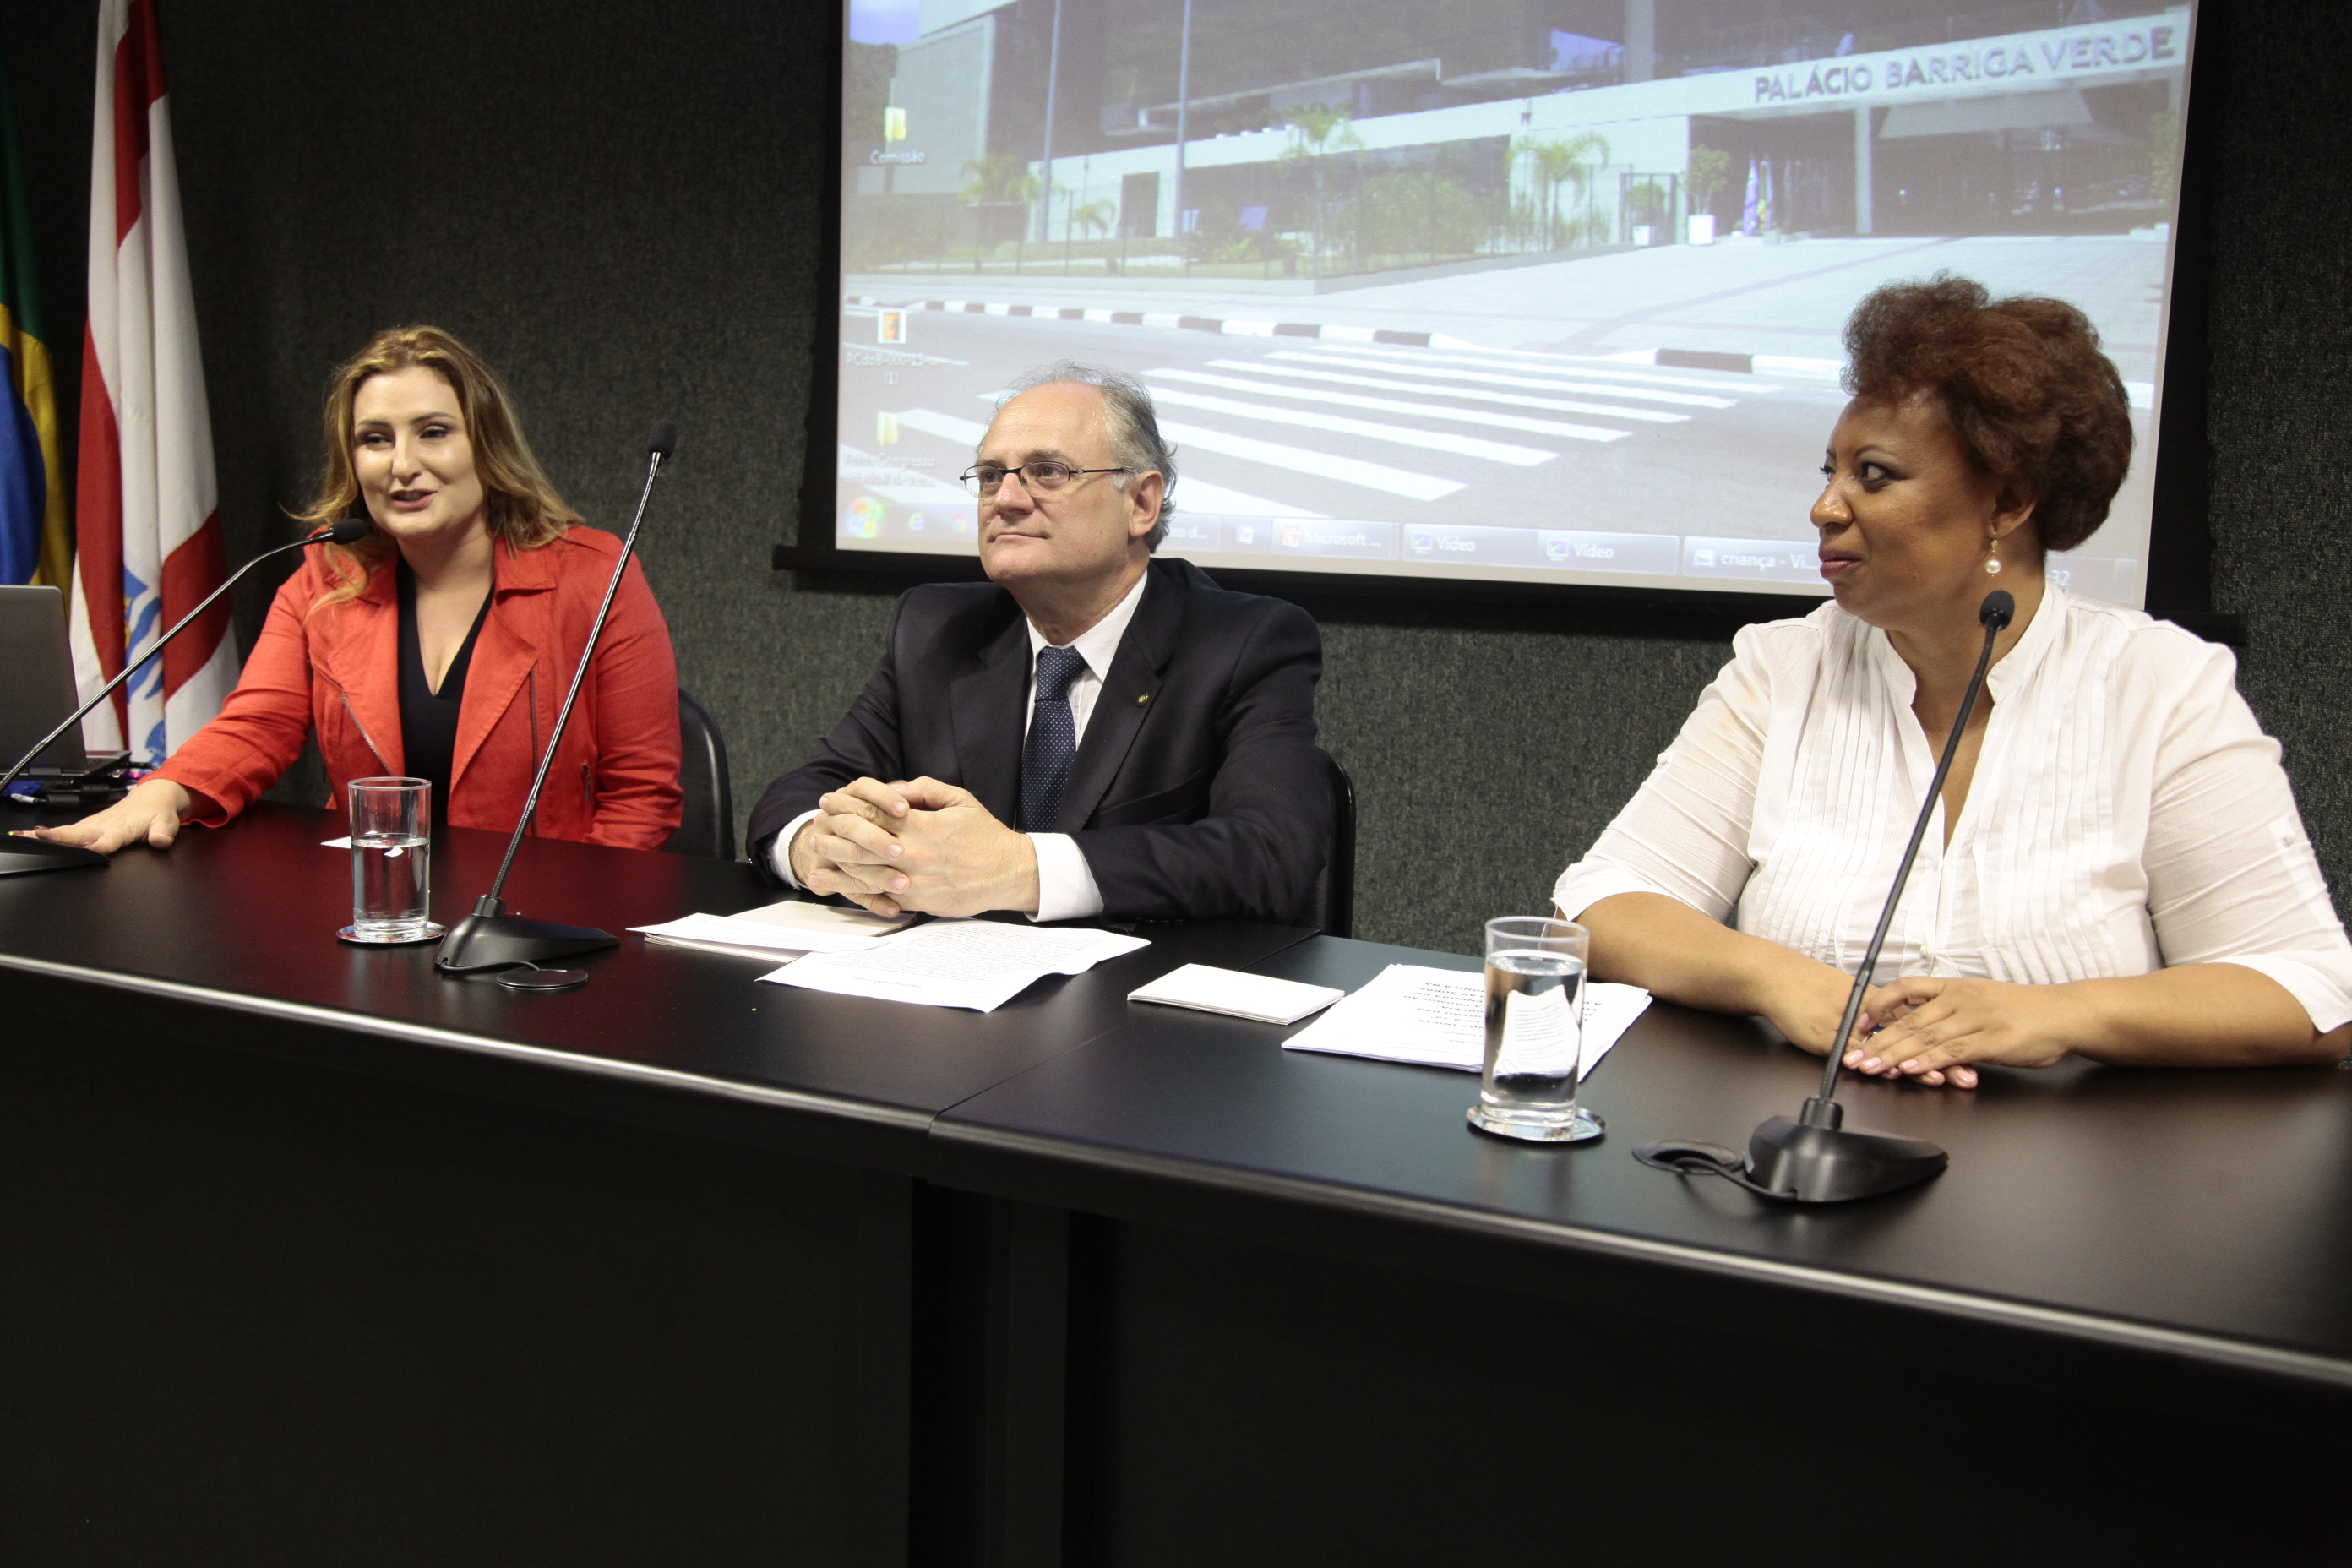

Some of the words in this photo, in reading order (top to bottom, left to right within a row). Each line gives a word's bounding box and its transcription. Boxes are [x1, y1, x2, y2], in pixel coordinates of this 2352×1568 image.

[1755, 63, 1872, 103] PALÁCIO
[1885, 46, 2034, 89] BARRIGA
[2039, 25, 2175, 69] VERDE
[869, 149, 926, 165] Comissão
[1304, 531, 1367, 547] Microsoft
[1720, 551, 1776, 571] criança
